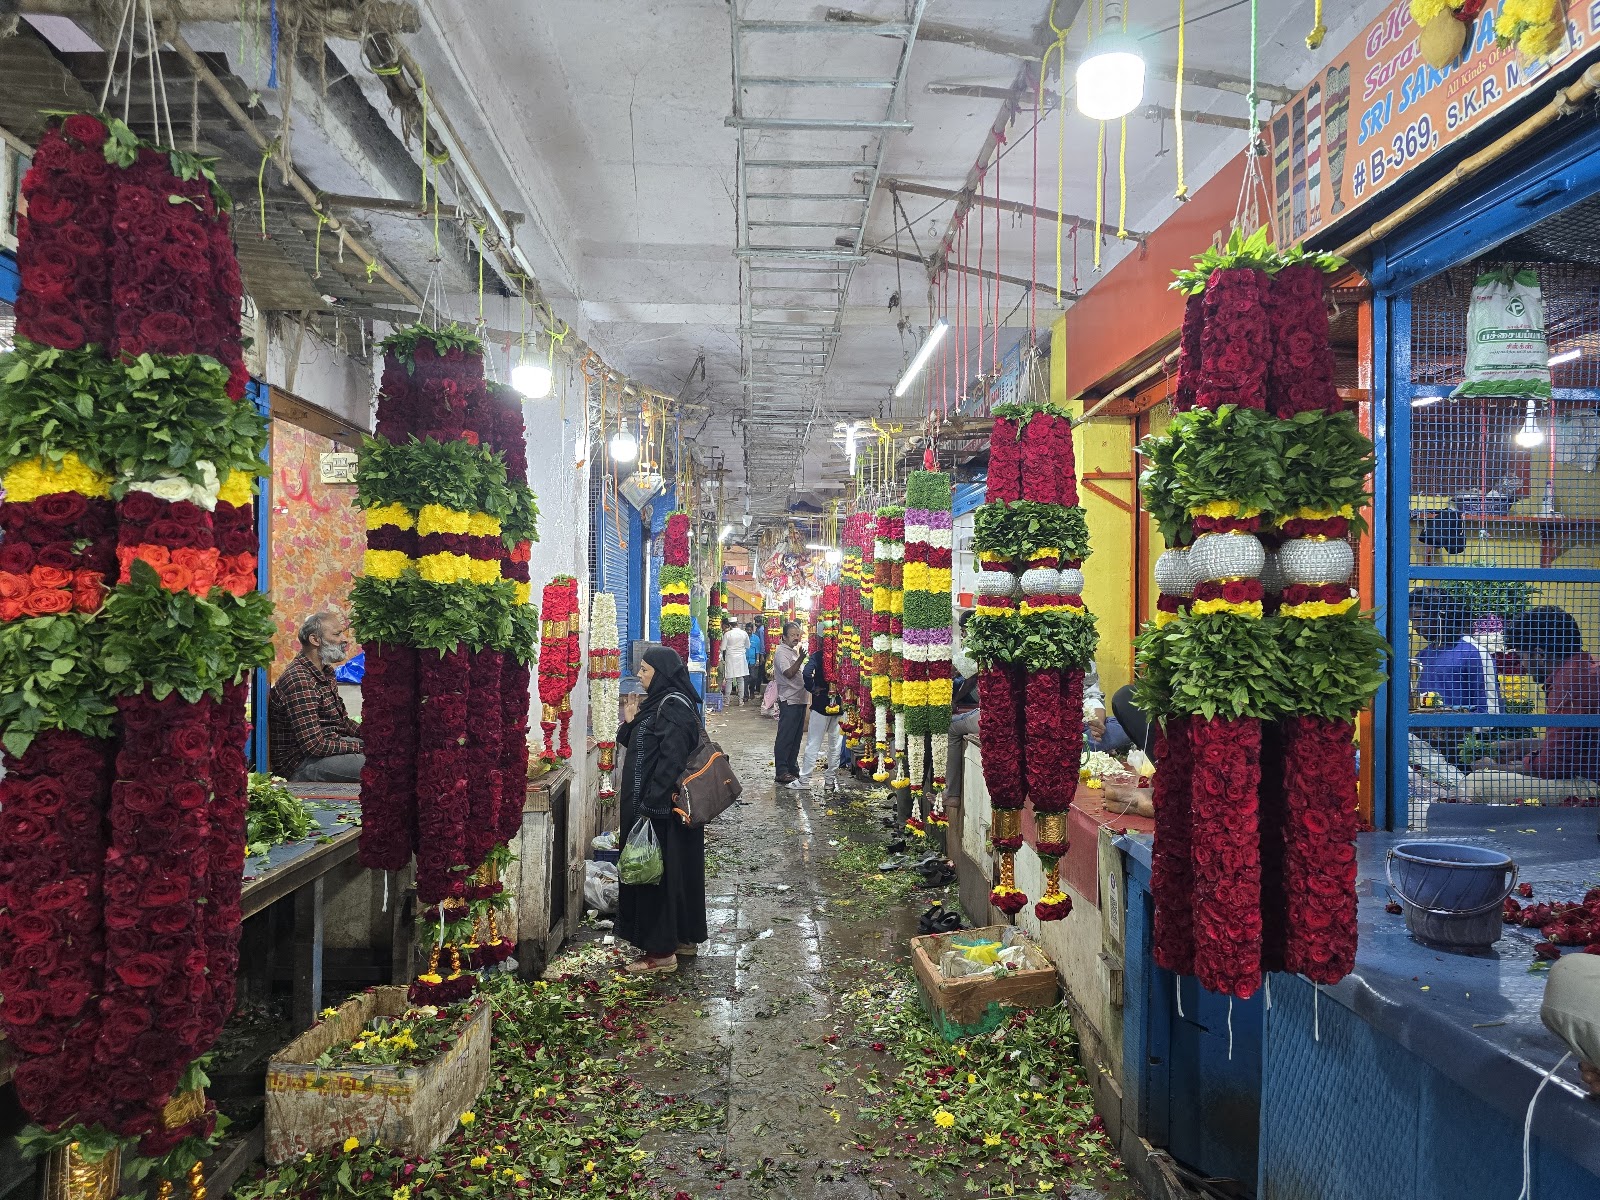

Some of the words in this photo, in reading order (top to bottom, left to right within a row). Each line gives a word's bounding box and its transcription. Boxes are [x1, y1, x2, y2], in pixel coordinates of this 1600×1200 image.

[1364, 39, 1421, 100] Sara
[1448, 79, 1461, 96] All
[1461, 60, 1487, 85] Kinds
[1488, 47, 1501, 64] Of
[1354, 161, 1366, 196] #
[1371, 116, 1438, 184] B-369,
[1447, 78, 1502, 129] S.K.R.
[1358, 92, 1393, 145] SRI
